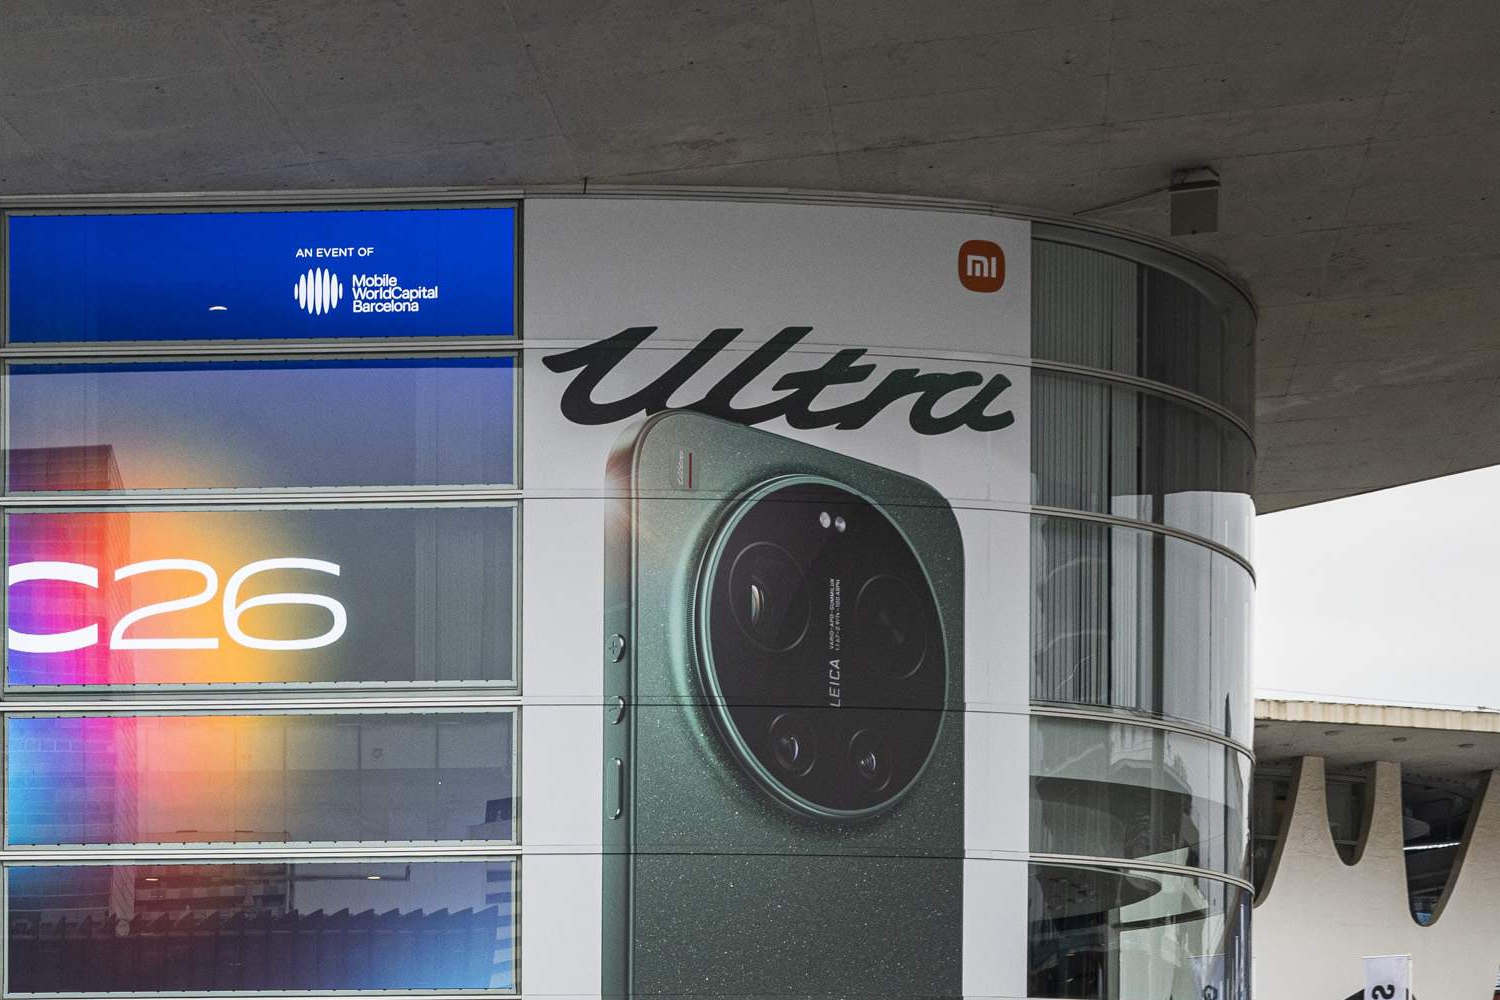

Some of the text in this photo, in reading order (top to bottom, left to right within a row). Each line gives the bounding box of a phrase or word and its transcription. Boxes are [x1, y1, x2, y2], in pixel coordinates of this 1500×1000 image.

[295, 247, 375, 258] AN EVENT OF
[352, 273, 398, 287] Mobile
[352, 285, 439, 301] WorldCapital
[352, 299, 420, 313] Barcelona
[541, 325, 1016, 437] Ultra
[828, 659, 841, 707] LEICA
